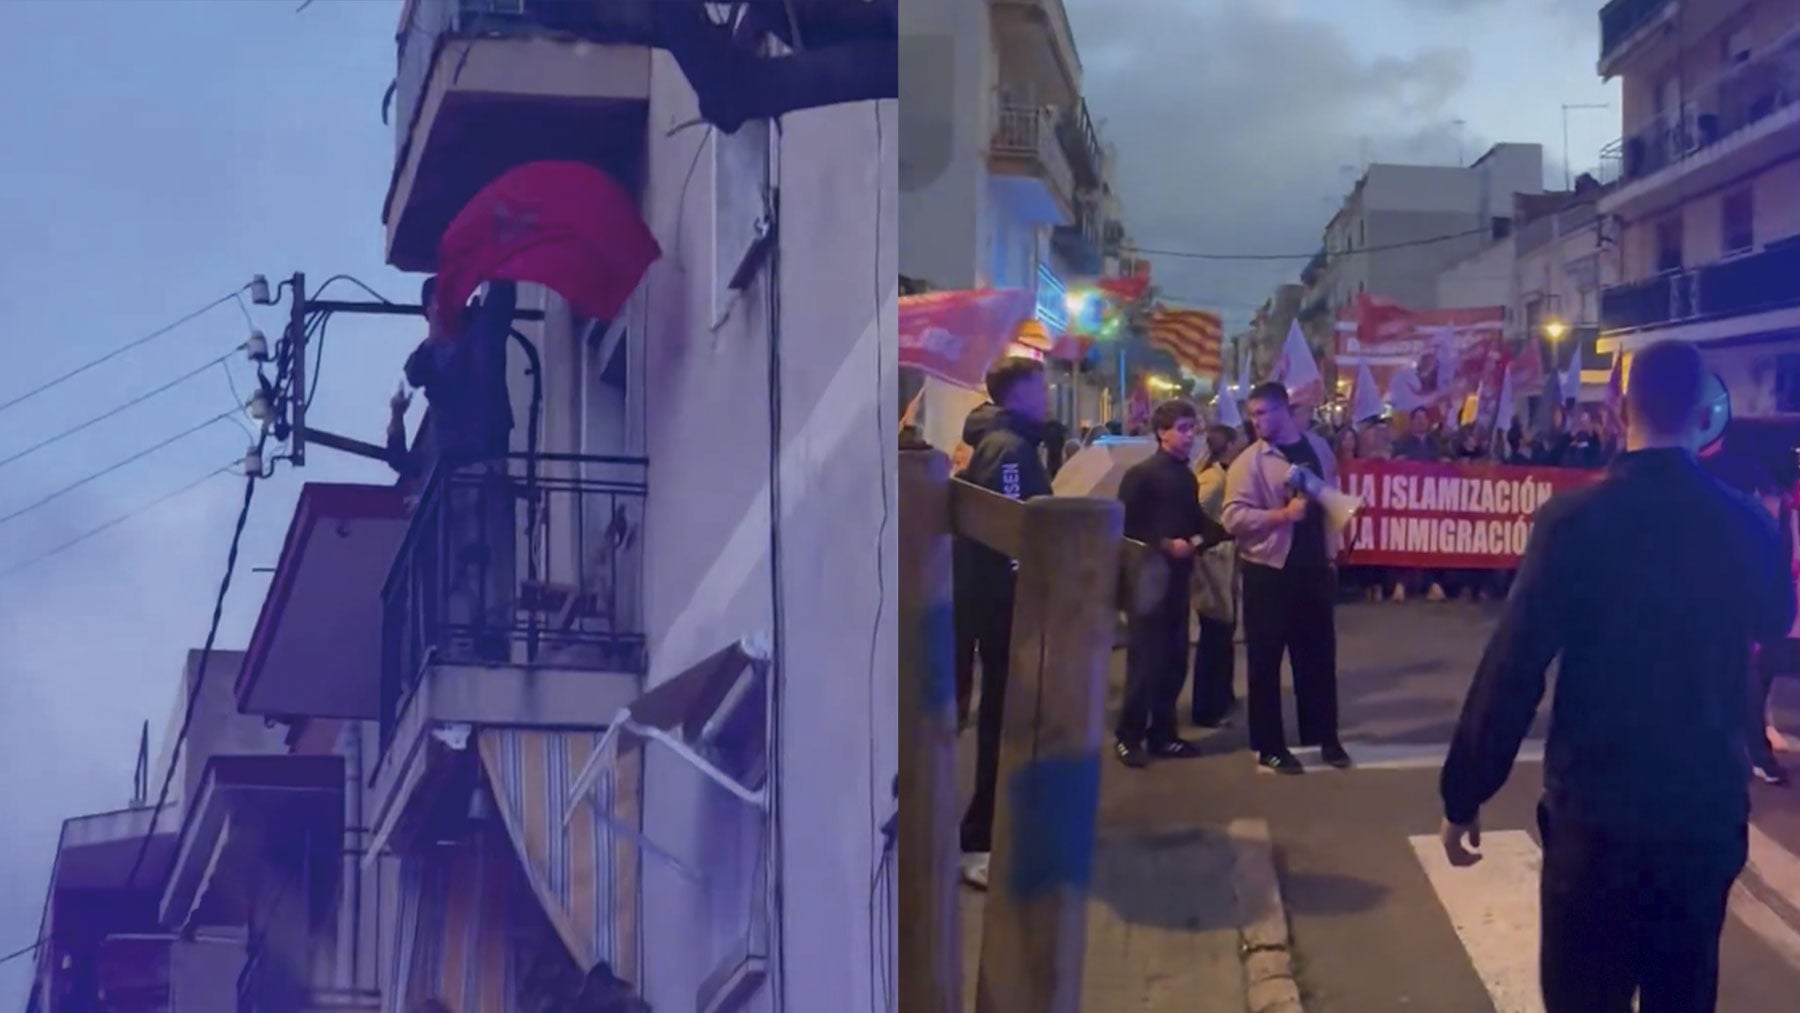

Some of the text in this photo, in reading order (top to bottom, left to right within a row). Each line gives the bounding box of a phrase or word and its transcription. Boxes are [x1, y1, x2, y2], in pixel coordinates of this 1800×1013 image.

[1381, 474, 1552, 515] ISLAMIZACIÓN
[1349, 516, 1375, 551] LA
[1380, 515, 1534, 556] INMIGRACIÓ
